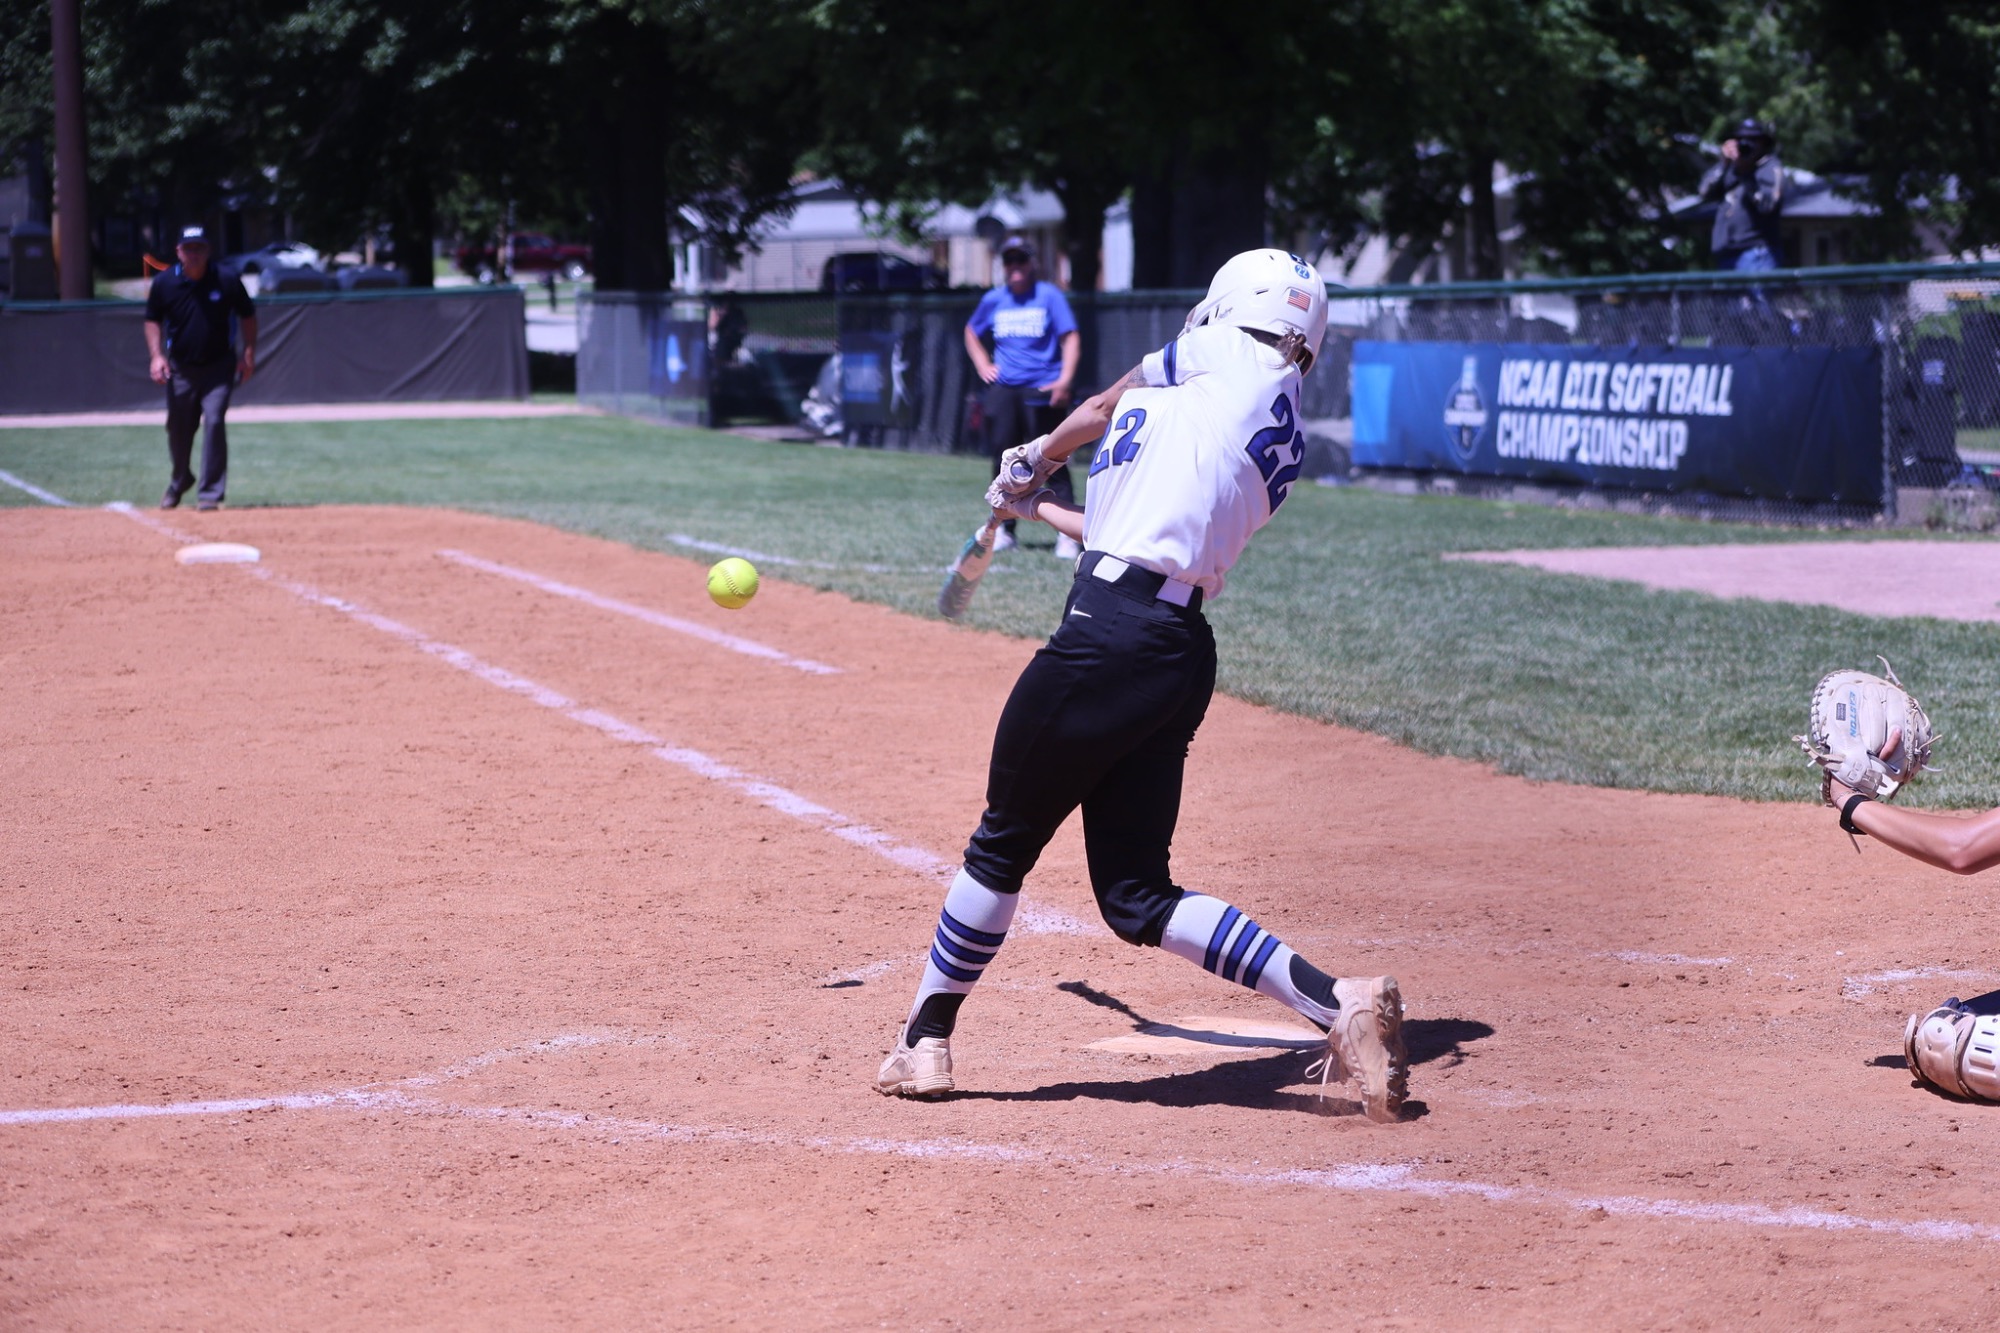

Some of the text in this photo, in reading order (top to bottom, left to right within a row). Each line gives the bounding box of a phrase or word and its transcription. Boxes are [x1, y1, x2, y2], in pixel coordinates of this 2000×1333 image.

[1296, 264, 1309, 278] 22
[1497, 359, 1733, 416] NCAA DII SOFTBALL
[1496, 411, 1689, 471] CHAMPIONSHIP
[1849, 691, 1857, 738] EASTON
